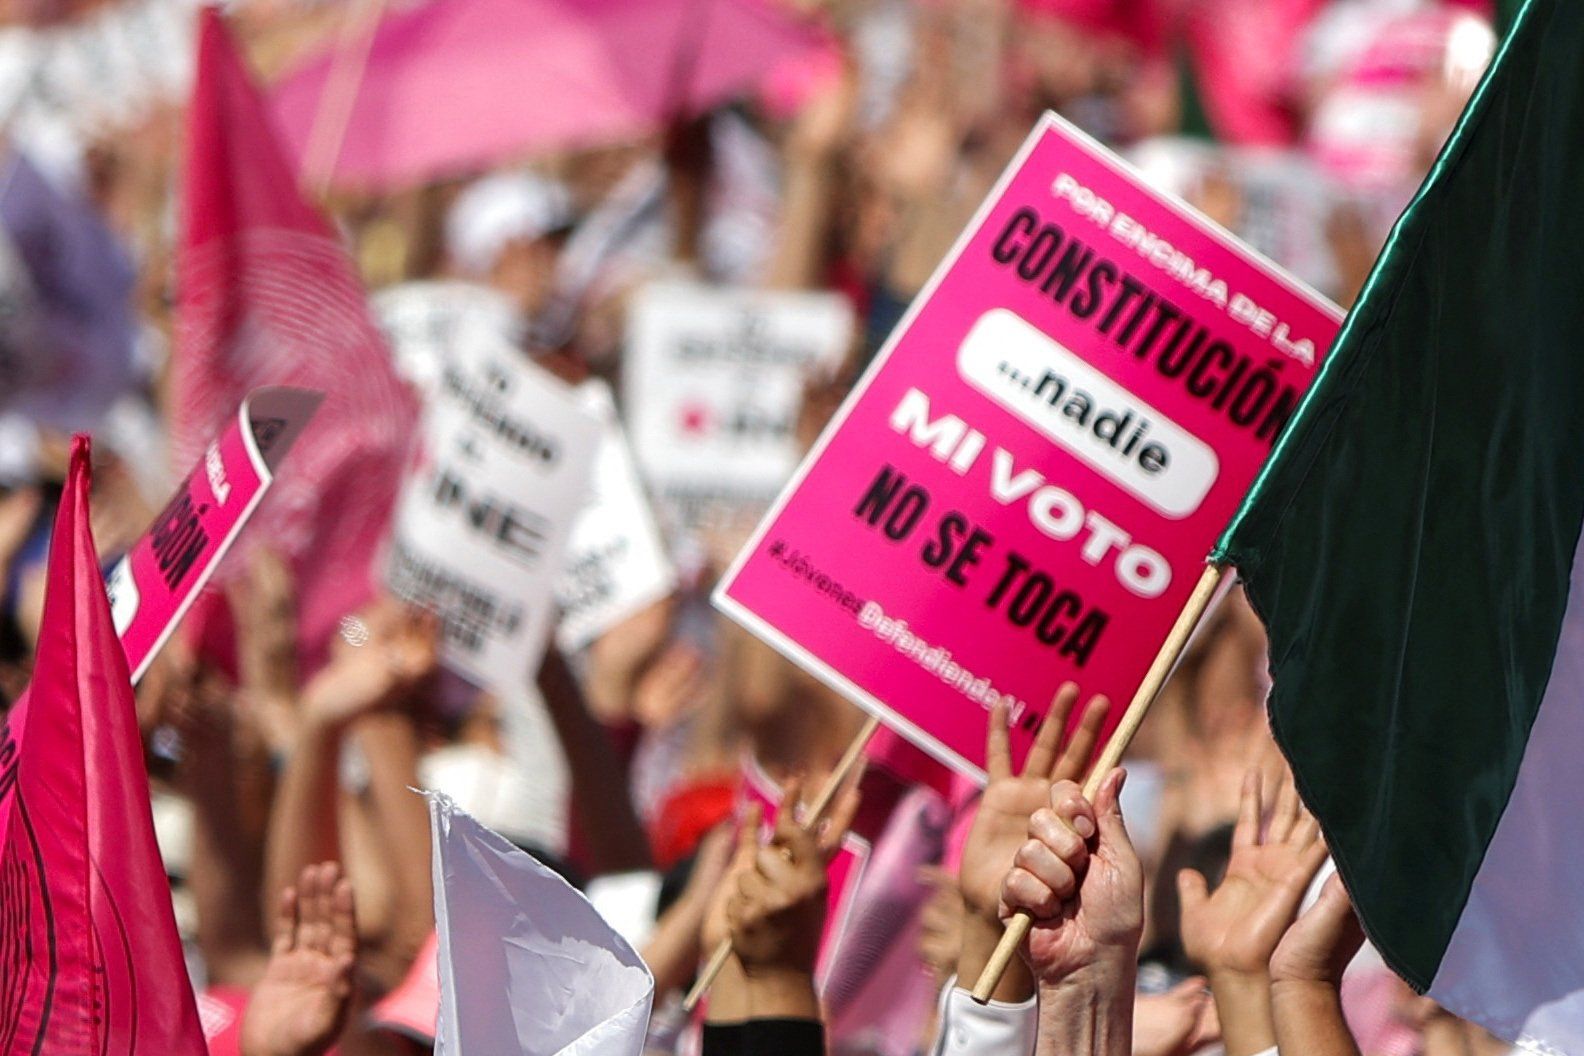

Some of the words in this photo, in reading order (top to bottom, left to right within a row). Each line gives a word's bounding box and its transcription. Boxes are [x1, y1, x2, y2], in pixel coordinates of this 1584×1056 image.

[1052, 172, 1116, 229] POR
[1109, 211, 1229, 311] ENCIMA
[1227, 292, 1279, 340] DE
[1270, 322, 1316, 369] LA
[854, 464, 928, 543] NO
[923, 510, 994, 588] SE
[986, 552, 1111, 668] TOCA
[889, 387, 987, 477] MI
[989, 445, 1173, 598] VOTO
